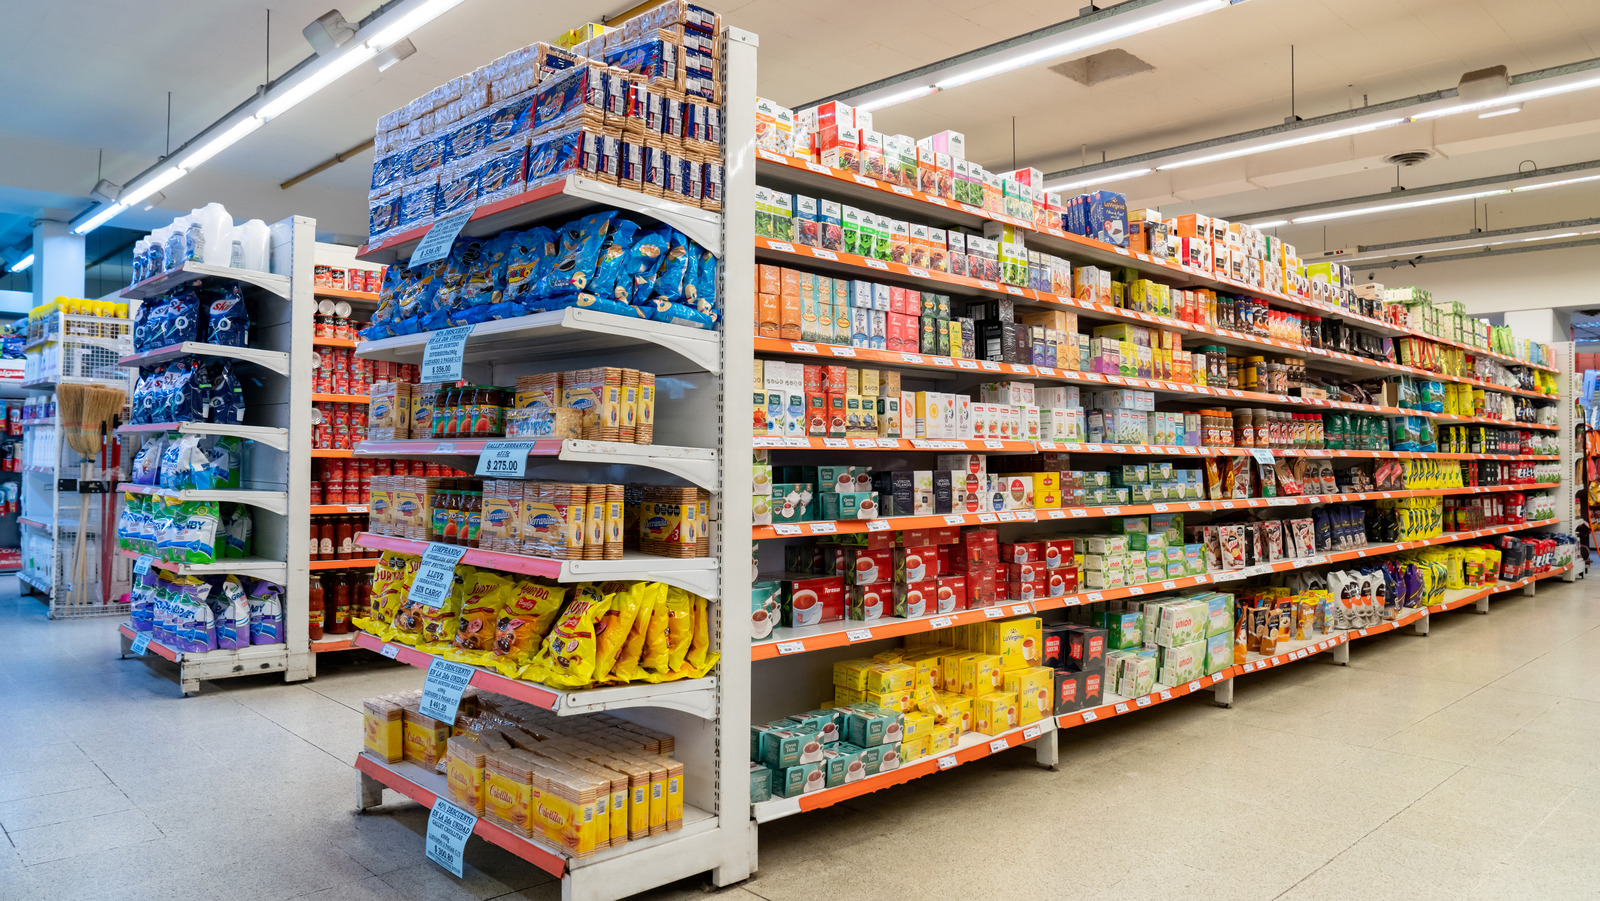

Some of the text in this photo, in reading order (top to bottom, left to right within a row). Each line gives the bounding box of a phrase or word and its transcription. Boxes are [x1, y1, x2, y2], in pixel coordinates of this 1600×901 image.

[487, 460, 517, 471] $ 275.00
[432, 545, 462, 556] COMPRANDO
[415, 585, 442, 598] SIN CARGO
[445, 664, 471, 676] DESCUENTO
[450, 675, 468, 685] UNIDAD
[490, 785, 513, 804] Criollitas
[438, 801, 473, 824] 40% DESCUENTO
[538, 802, 564, 826] Criollitas
[432, 820, 463, 841] GALLET CRIOLLITAS
[452, 820, 470, 834] UNIDAD
